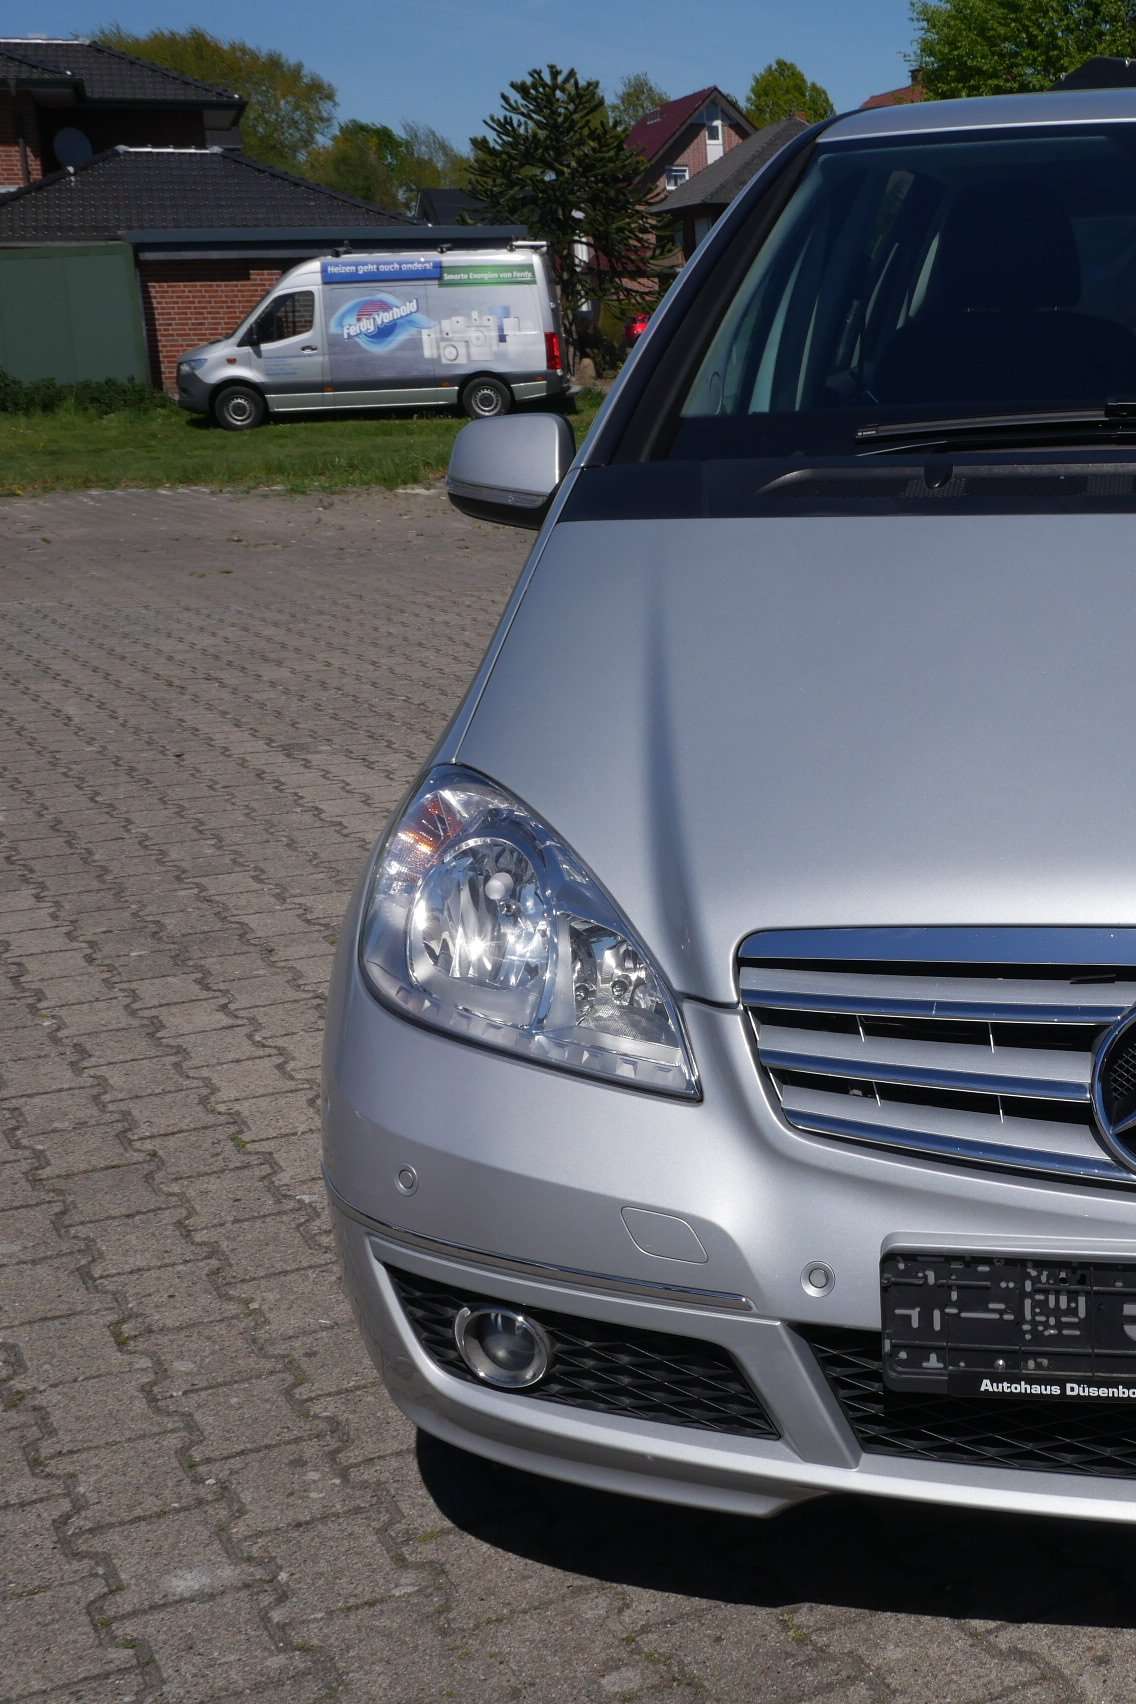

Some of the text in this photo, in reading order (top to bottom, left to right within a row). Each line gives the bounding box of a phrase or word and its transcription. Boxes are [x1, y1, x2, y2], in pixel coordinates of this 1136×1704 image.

[328, 262, 433, 274] Heizen geht auch anders!
[343, 317, 374, 339] Ferdy
[980, 1379, 1061, 1396] Autohaus
